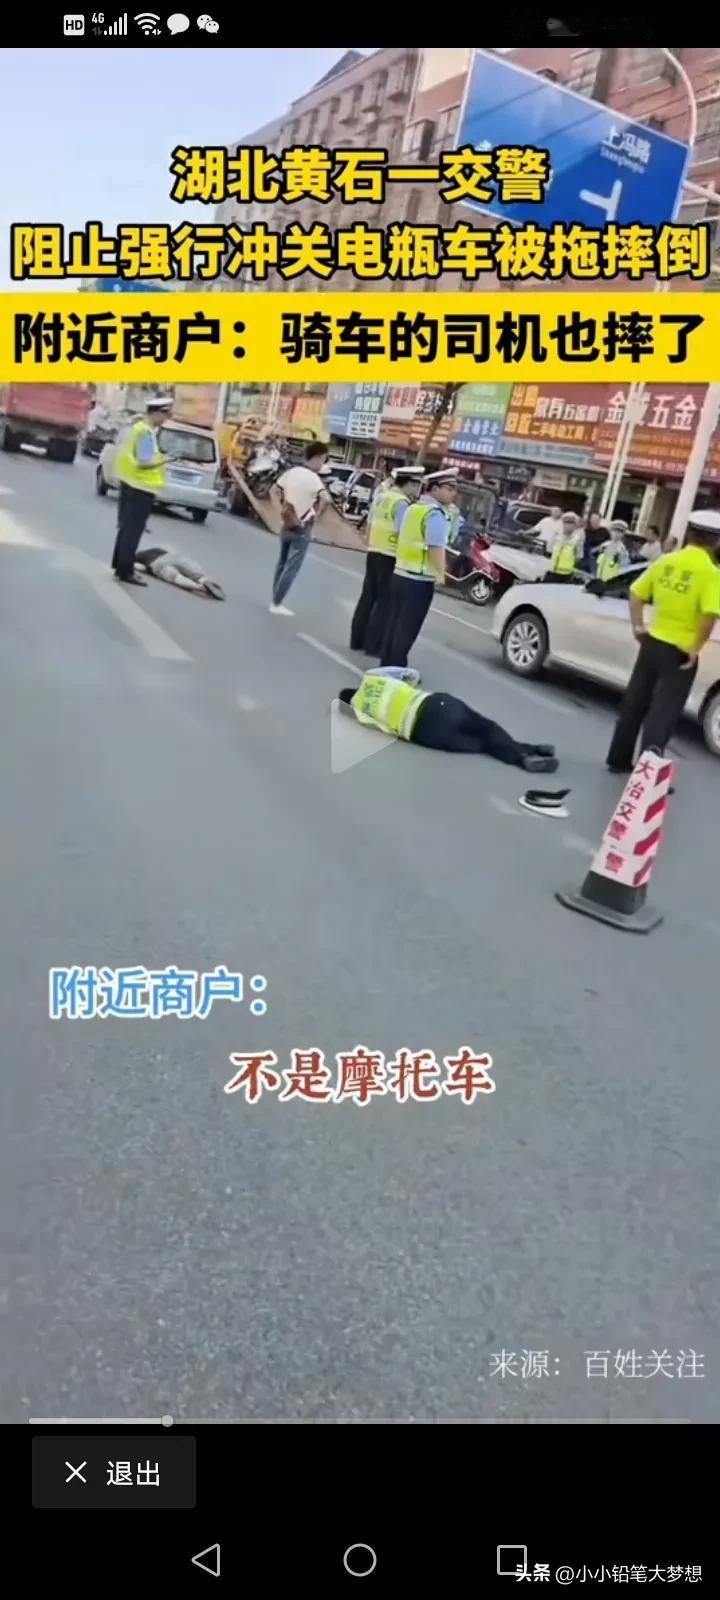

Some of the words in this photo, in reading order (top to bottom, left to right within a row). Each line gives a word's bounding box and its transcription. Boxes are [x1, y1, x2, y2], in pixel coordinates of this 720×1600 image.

[91, 12, 105, 24] 4G
[65, 19, 83, 31] HD
[106, 1459, 161, 1487] 退出
